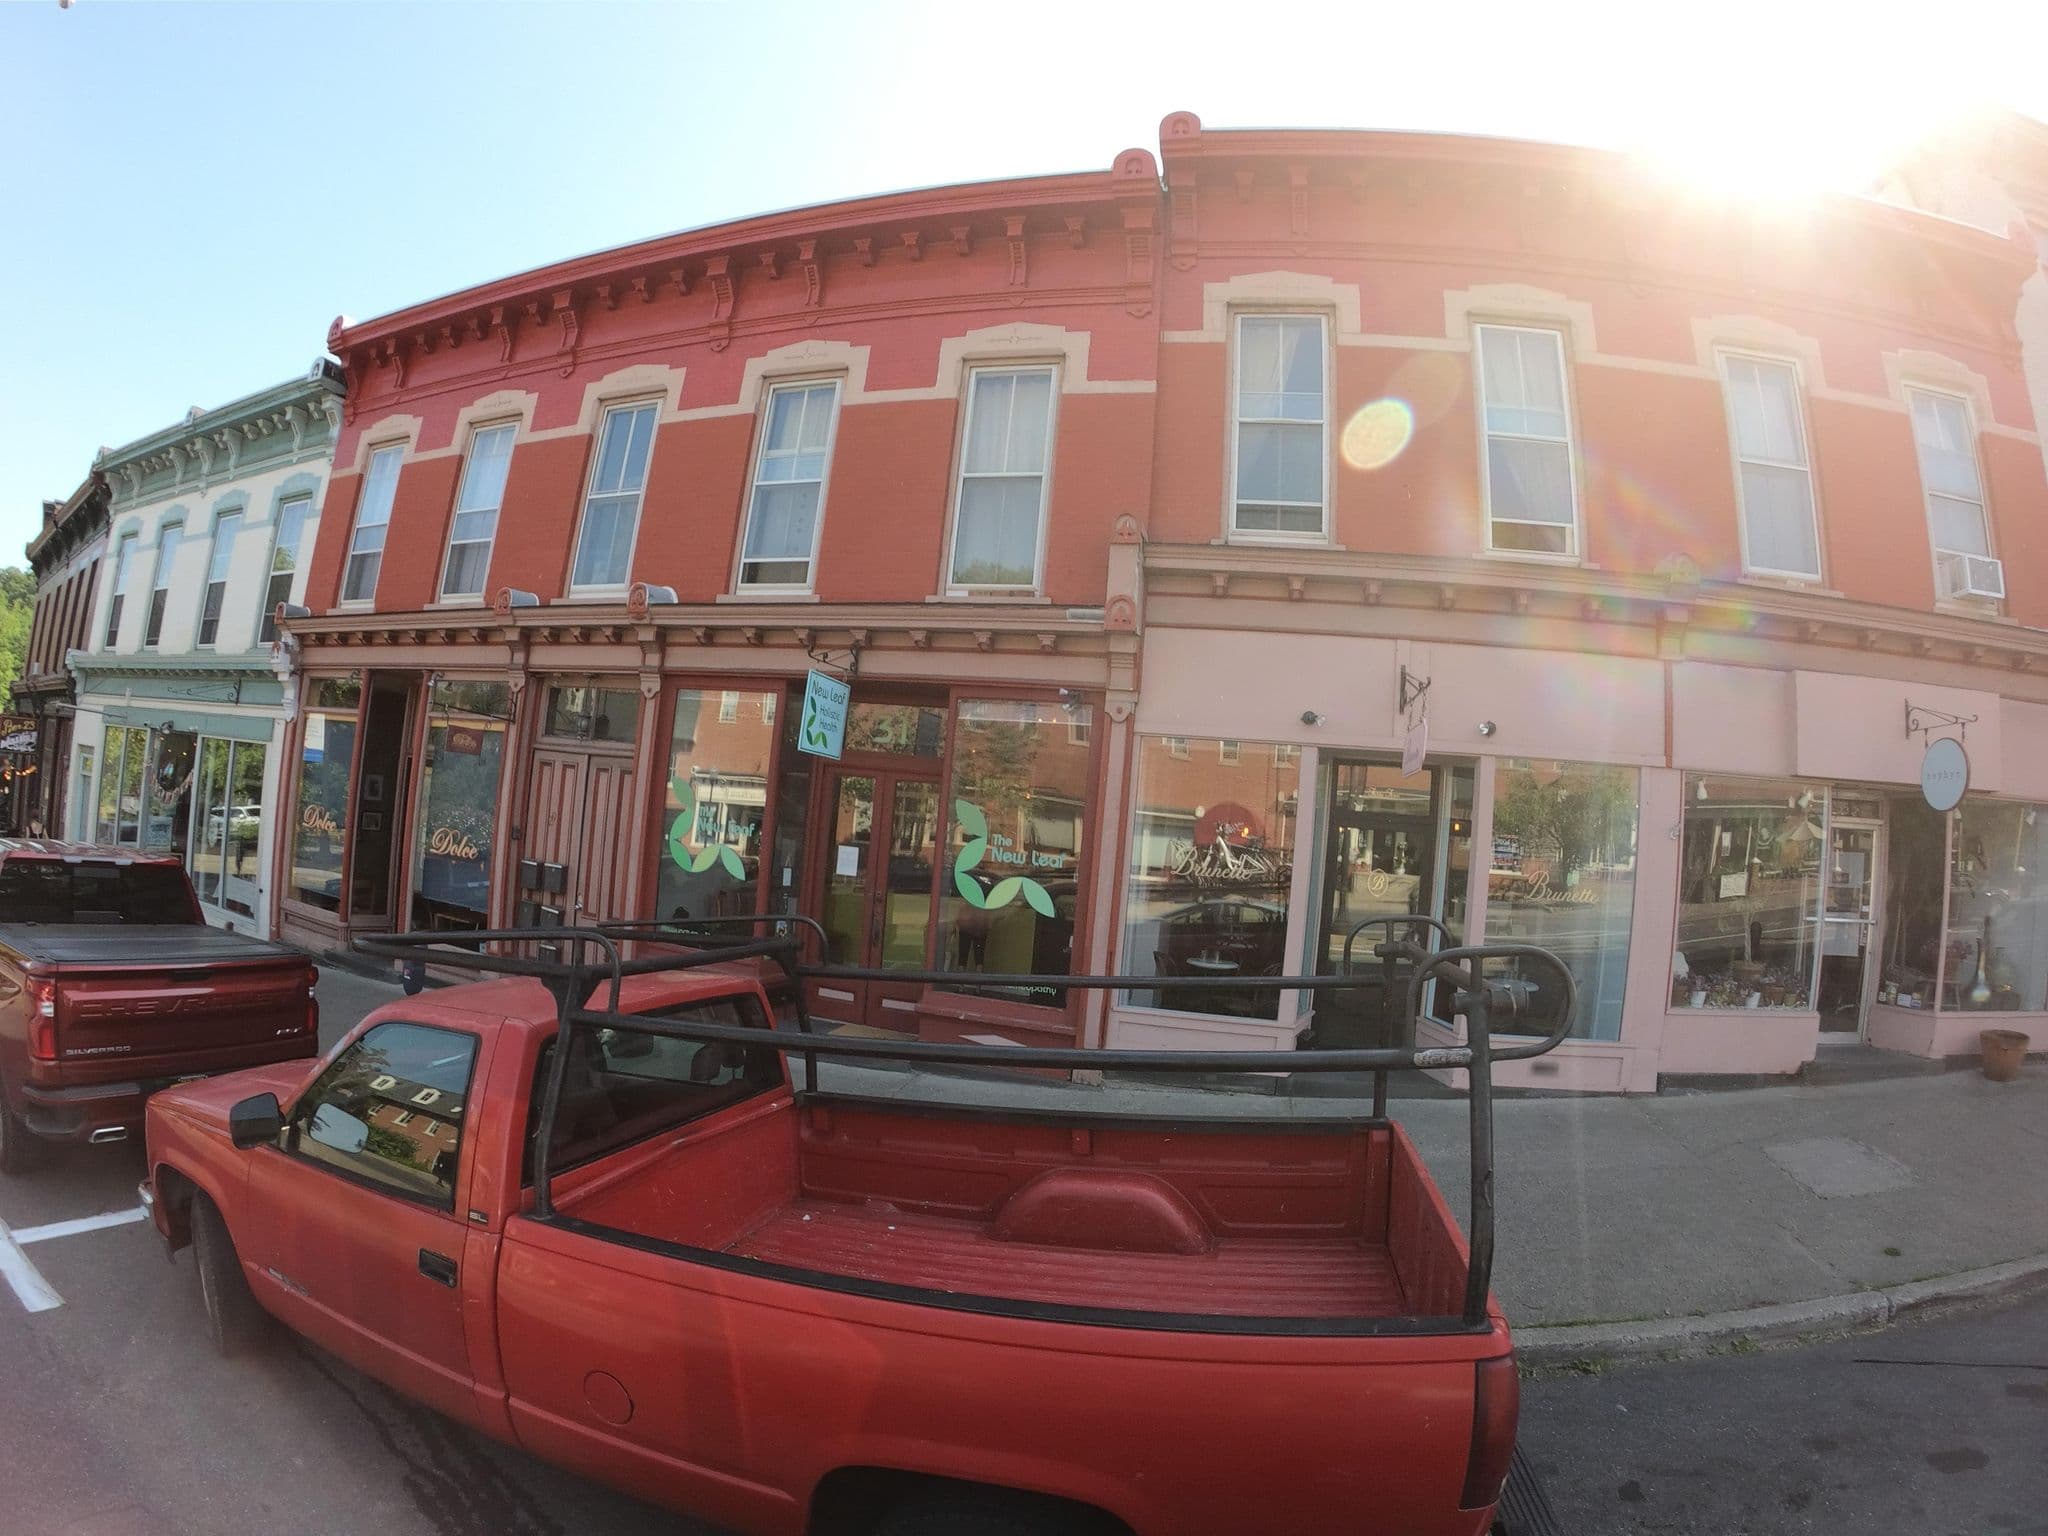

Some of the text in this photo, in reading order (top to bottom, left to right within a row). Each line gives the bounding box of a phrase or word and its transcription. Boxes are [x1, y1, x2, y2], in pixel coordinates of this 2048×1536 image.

[812, 680, 829, 699] New
[302, 804, 338, 832] Dolce
[697, 817, 725, 834] New
[430, 827, 479, 860] Dolce
[991, 834, 1013, 847] The
[991, 847, 1028, 865] New
[1170, 845, 1253, 880] Brunette
[1371, 875, 1385, 891] B
[1523, 870, 1601, 904] Brunette
[66, 1045, 131, 1056] SILVERADO
